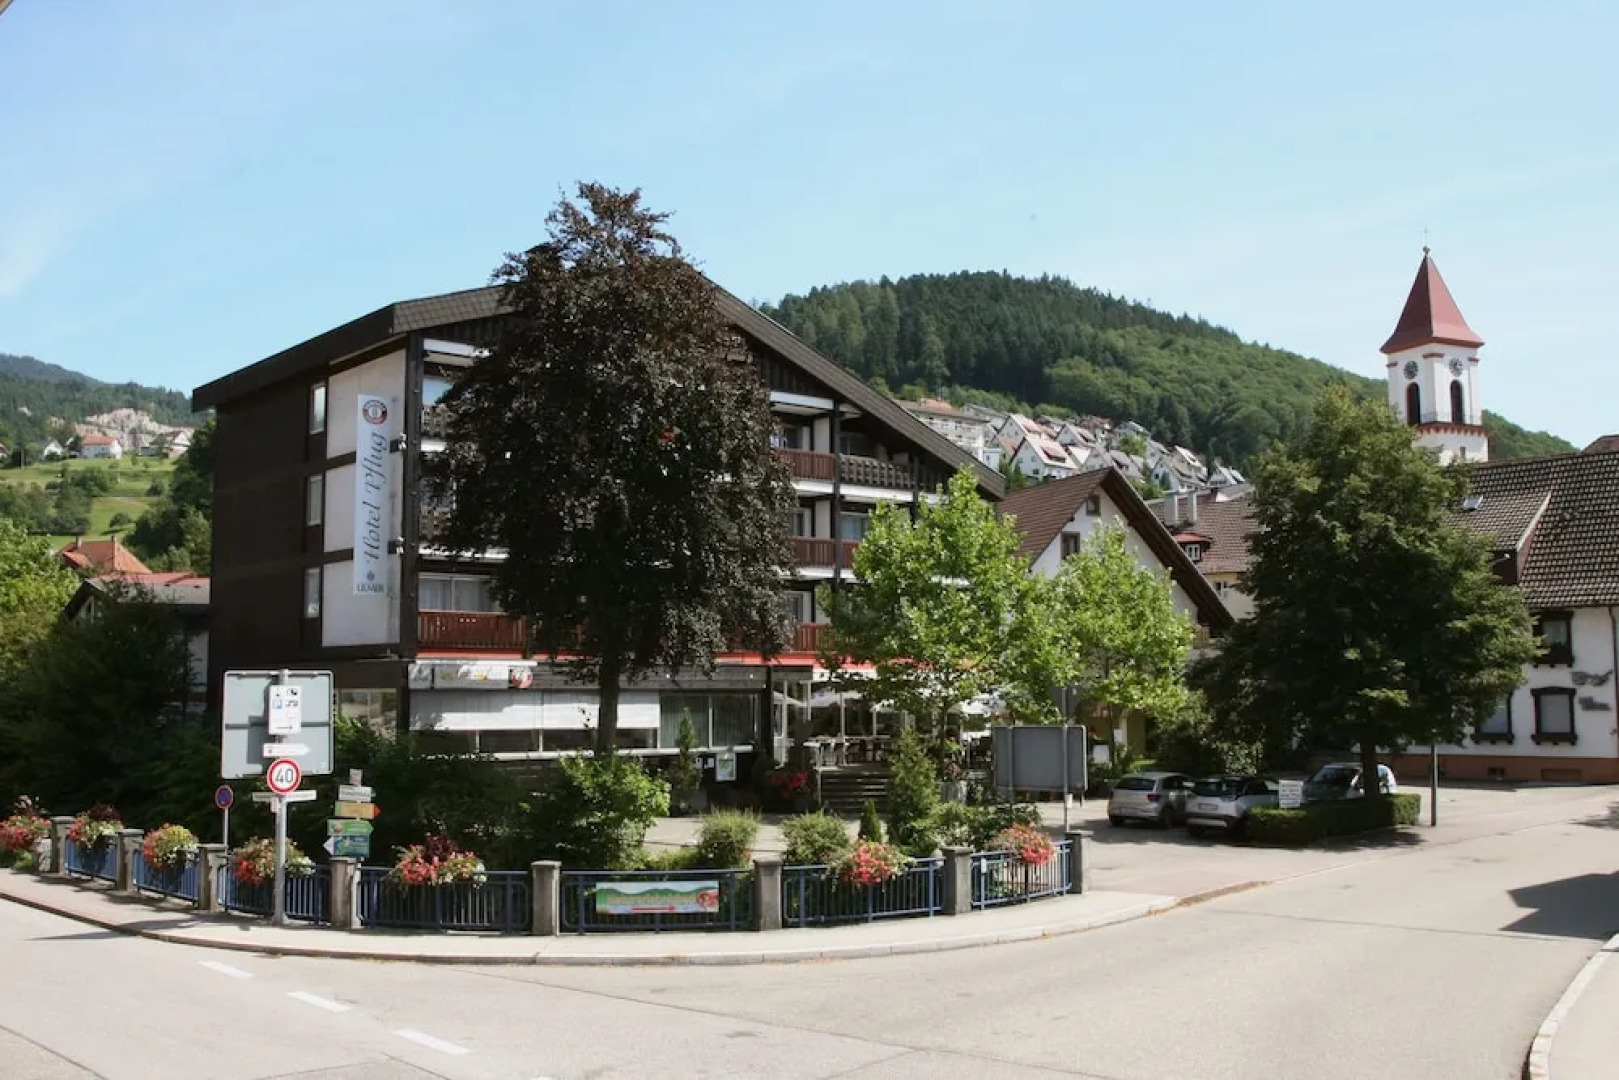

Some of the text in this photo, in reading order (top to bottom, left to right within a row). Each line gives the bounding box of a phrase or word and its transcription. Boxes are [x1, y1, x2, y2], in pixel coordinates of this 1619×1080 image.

[361, 432, 388, 493] Pflug
[362, 501, 381, 563] Hotel
[275, 768, 294, 783] 40
